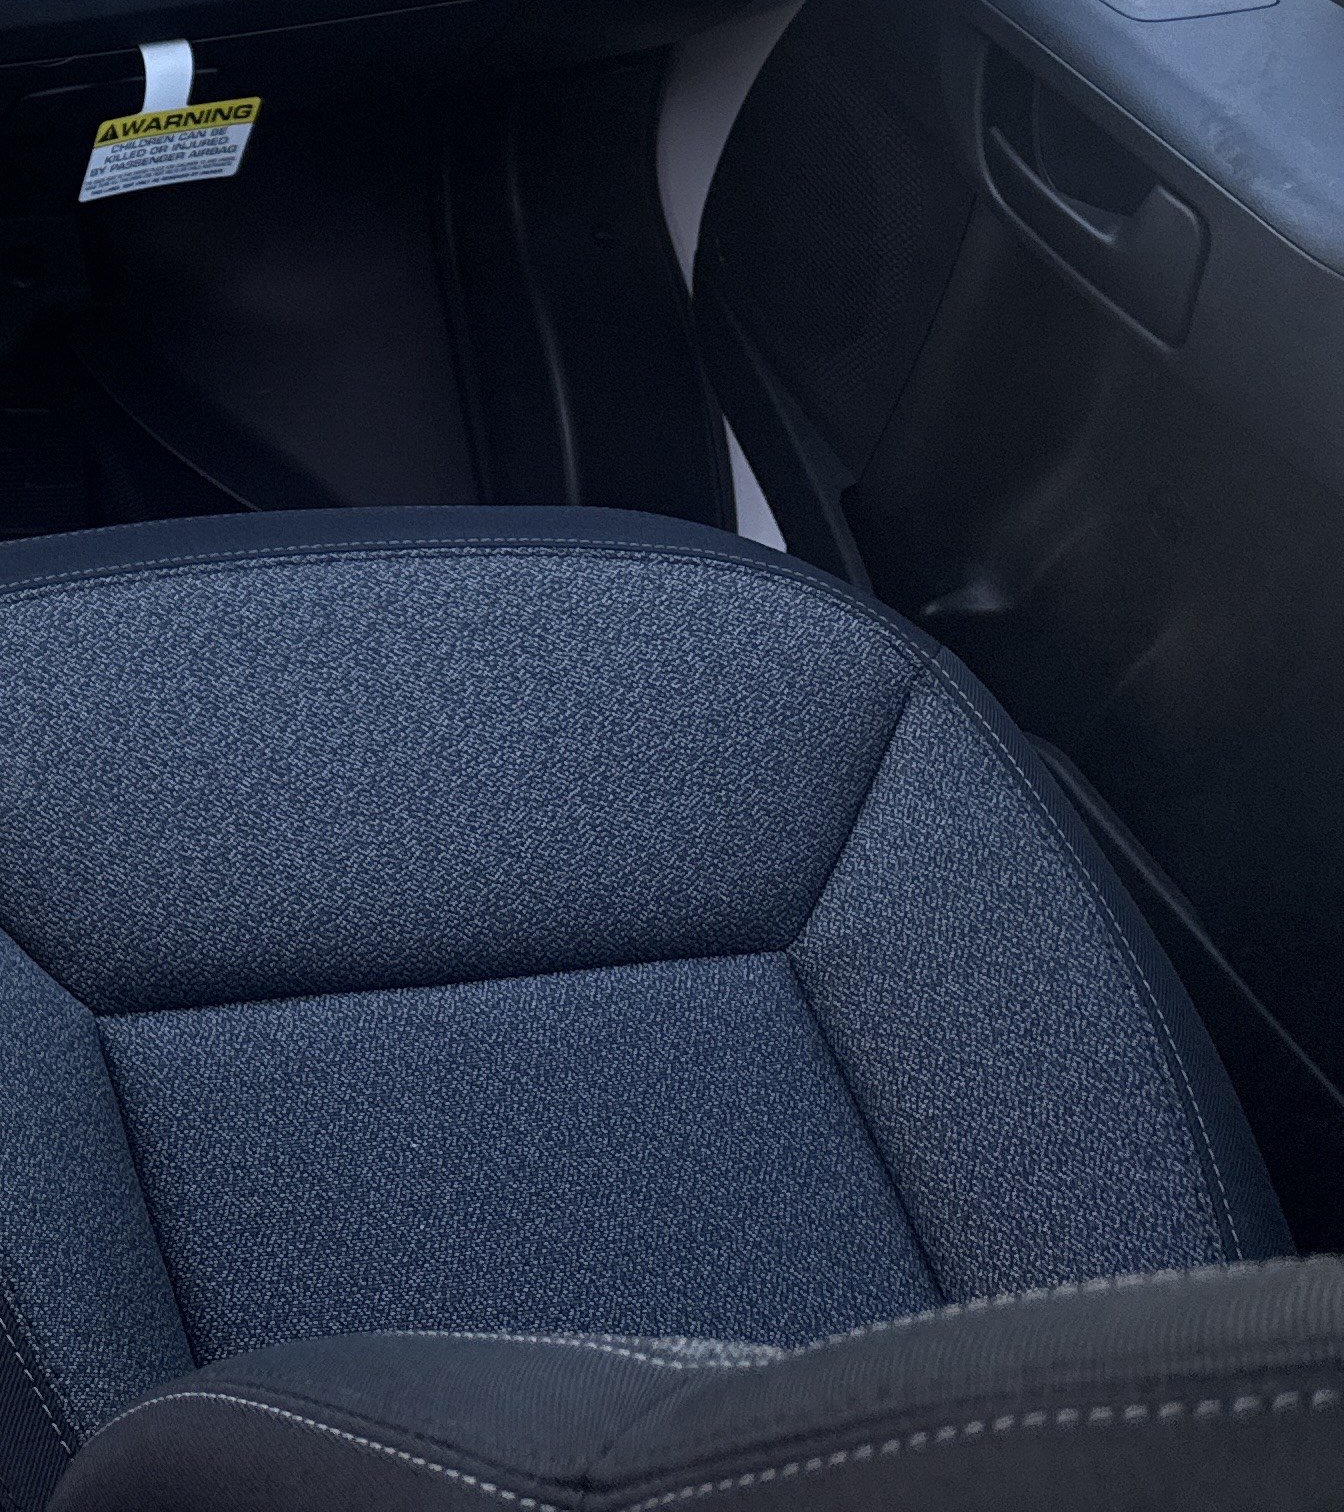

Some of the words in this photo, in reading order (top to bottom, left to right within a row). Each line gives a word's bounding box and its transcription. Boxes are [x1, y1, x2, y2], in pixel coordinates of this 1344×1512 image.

[121, 103, 254, 137] WARNING
[104, 148, 147, 165] KILLED
[149, 144, 168, 155] OR
[172, 137, 229, 151] INJURED
[111, 134, 175, 153] CHILDREN
[178, 128, 207, 141] CAN
[210, 126, 228, 137] BE
[90, 166, 107, 178] BY
[110, 151, 185, 173] PASSENGER
[188, 144, 239, 159] AIRBAG
